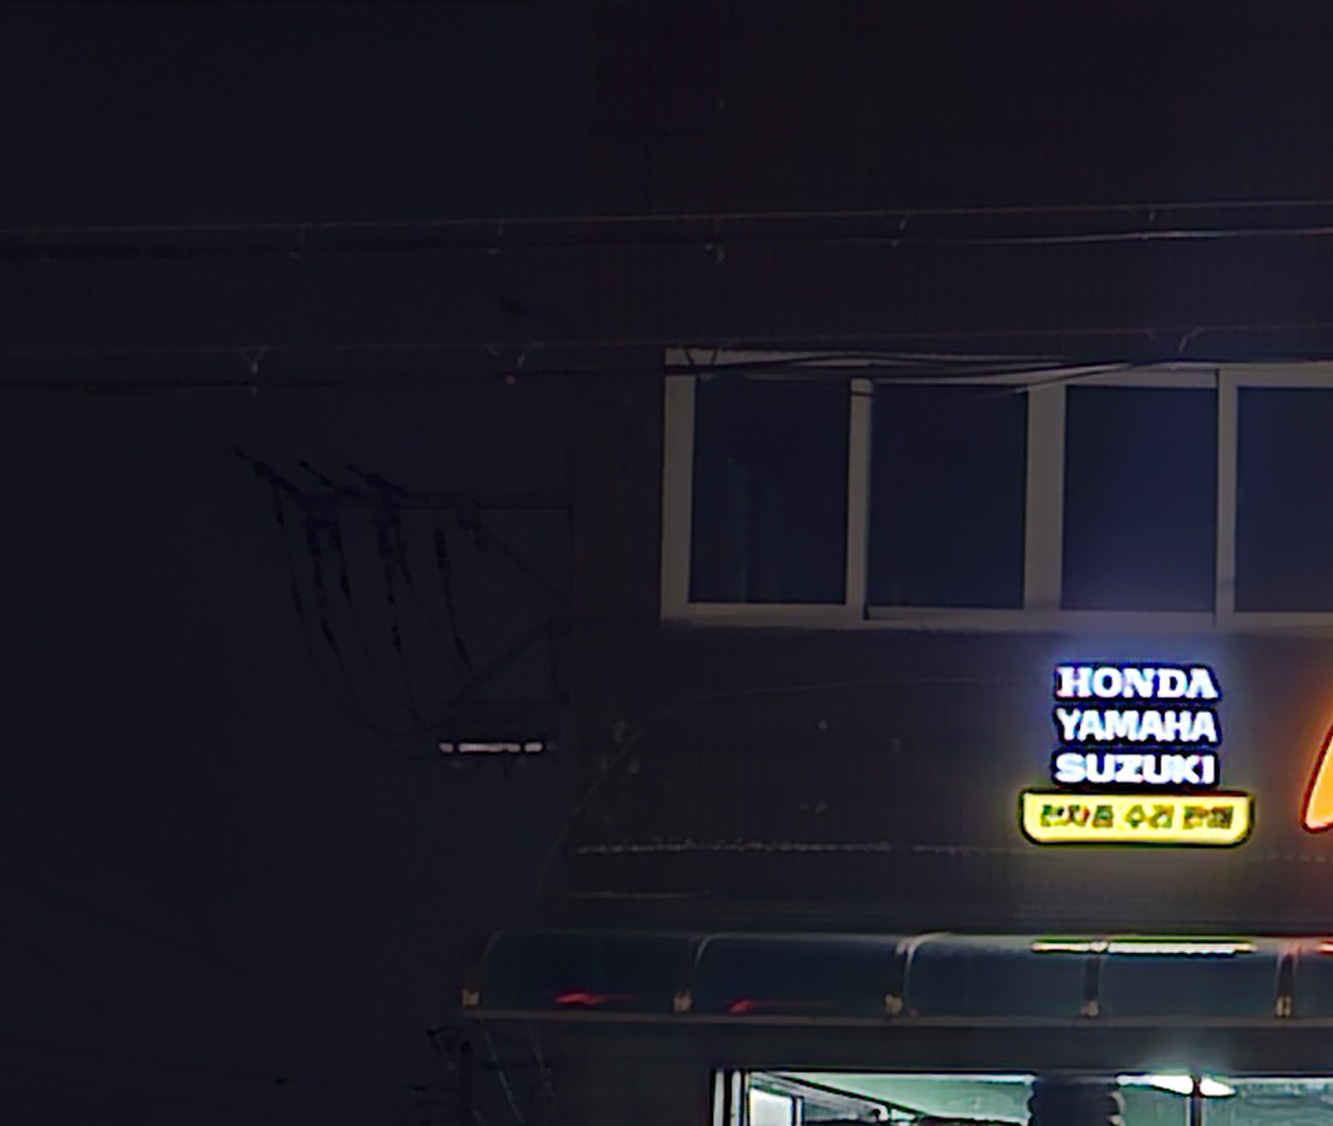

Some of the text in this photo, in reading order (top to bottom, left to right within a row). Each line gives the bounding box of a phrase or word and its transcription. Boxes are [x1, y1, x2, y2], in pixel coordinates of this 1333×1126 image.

[1056, 666, 1219, 699] HONDA
[1056, 707, 1219, 742] YAMAHA
[1054, 752, 1216, 785] SUZUKI
